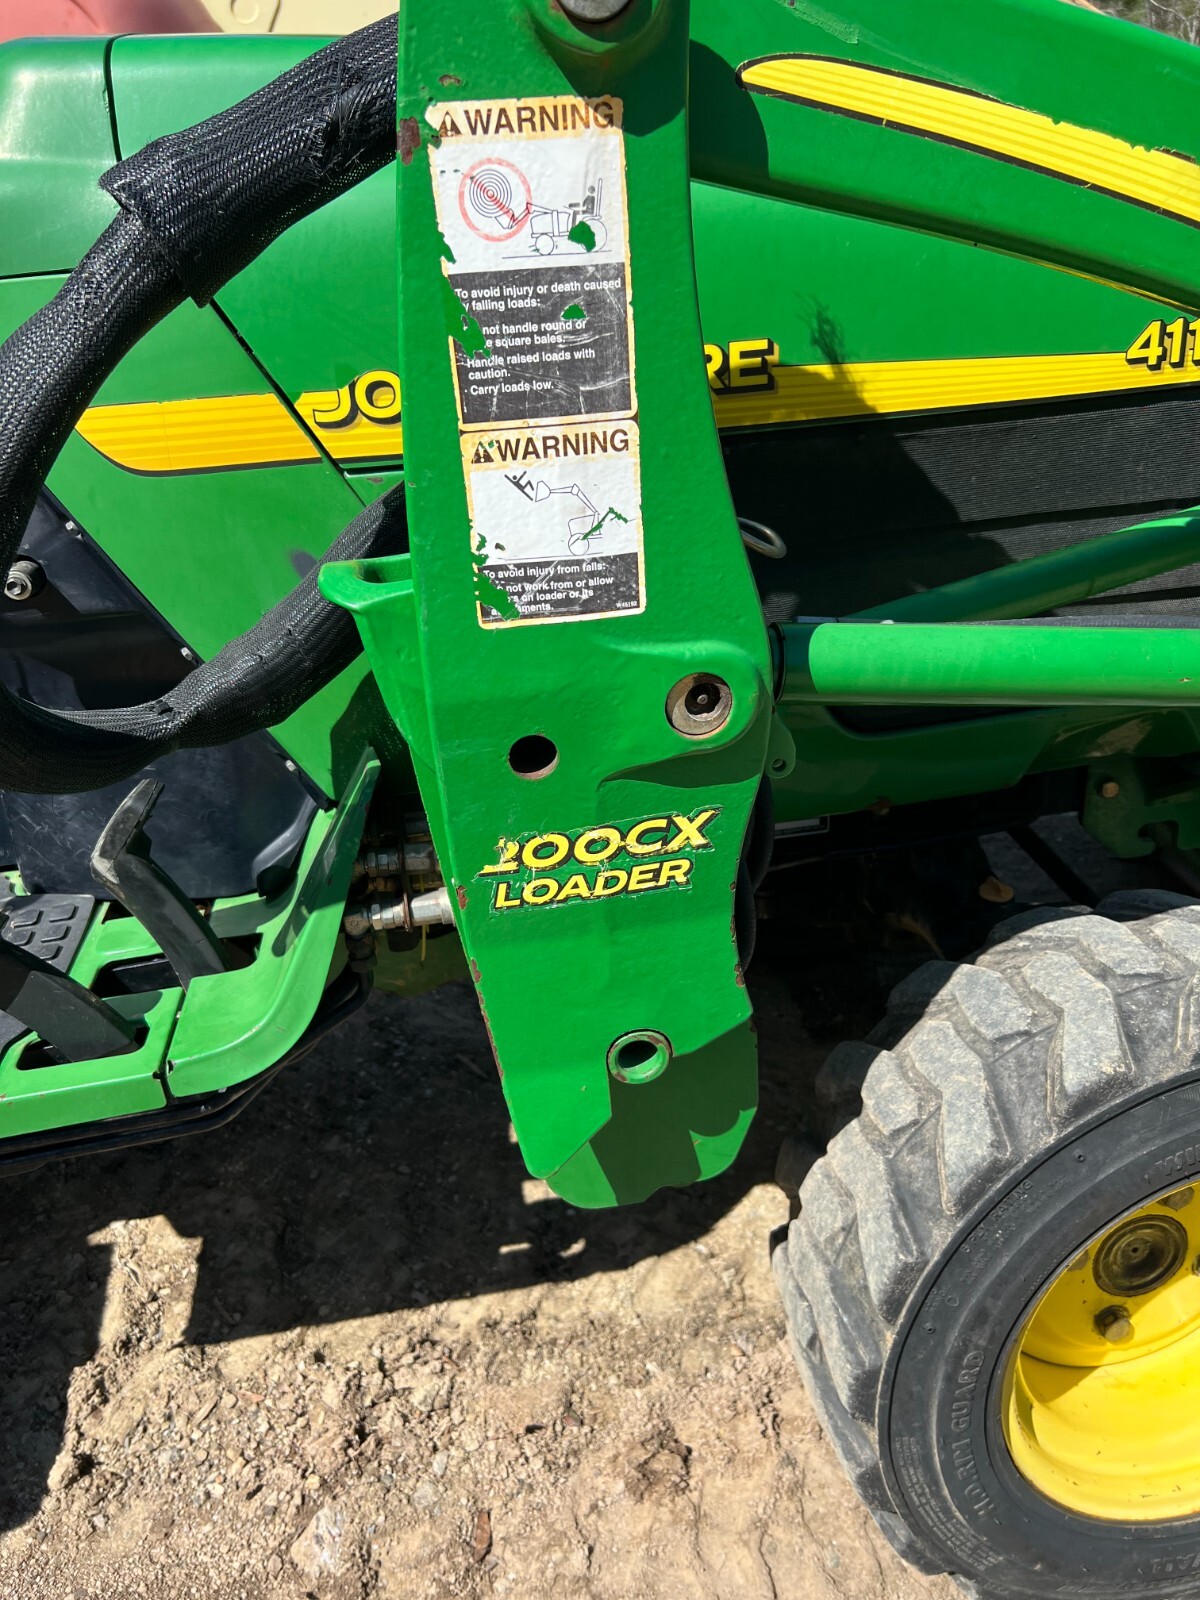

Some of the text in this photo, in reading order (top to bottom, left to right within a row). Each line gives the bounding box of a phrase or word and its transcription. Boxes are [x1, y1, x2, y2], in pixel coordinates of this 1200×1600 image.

[464, 101, 614, 136] WARNING
[455, 278, 621, 299] To avoid injury or death caused
[472, 299, 505, 312] falling
[508, 298, 541, 309] loads:
[483, 320, 587, 335] not handle round or
[495, 336, 532, 349] square
[534, 333, 566, 345] bales.
[467, 348, 595, 368] Handle raised loads with
[468, 368, 511, 380] caution.
[470, 380, 554, 397] Carry loads low.
[312, 369, 402, 429] JO
[496, 429, 629, 462] WARNING
[483, 562, 607, 579] To avoid injury from falls:
[506, 582, 523, 593] not
[524, 580, 548, 592] work
[550, 579, 574, 589] from
[588, 576, 614, 586] allow
[521, 593, 534, 601] on
[536, 590, 567, 601] loader
[568, 590, 579, 598] or
[582, 588, 594, 598] its
[478, 807, 723, 876] 200CX
[494, 858, 693, 911] LOADER
[951, 1350, 986, 1433] GUARD
